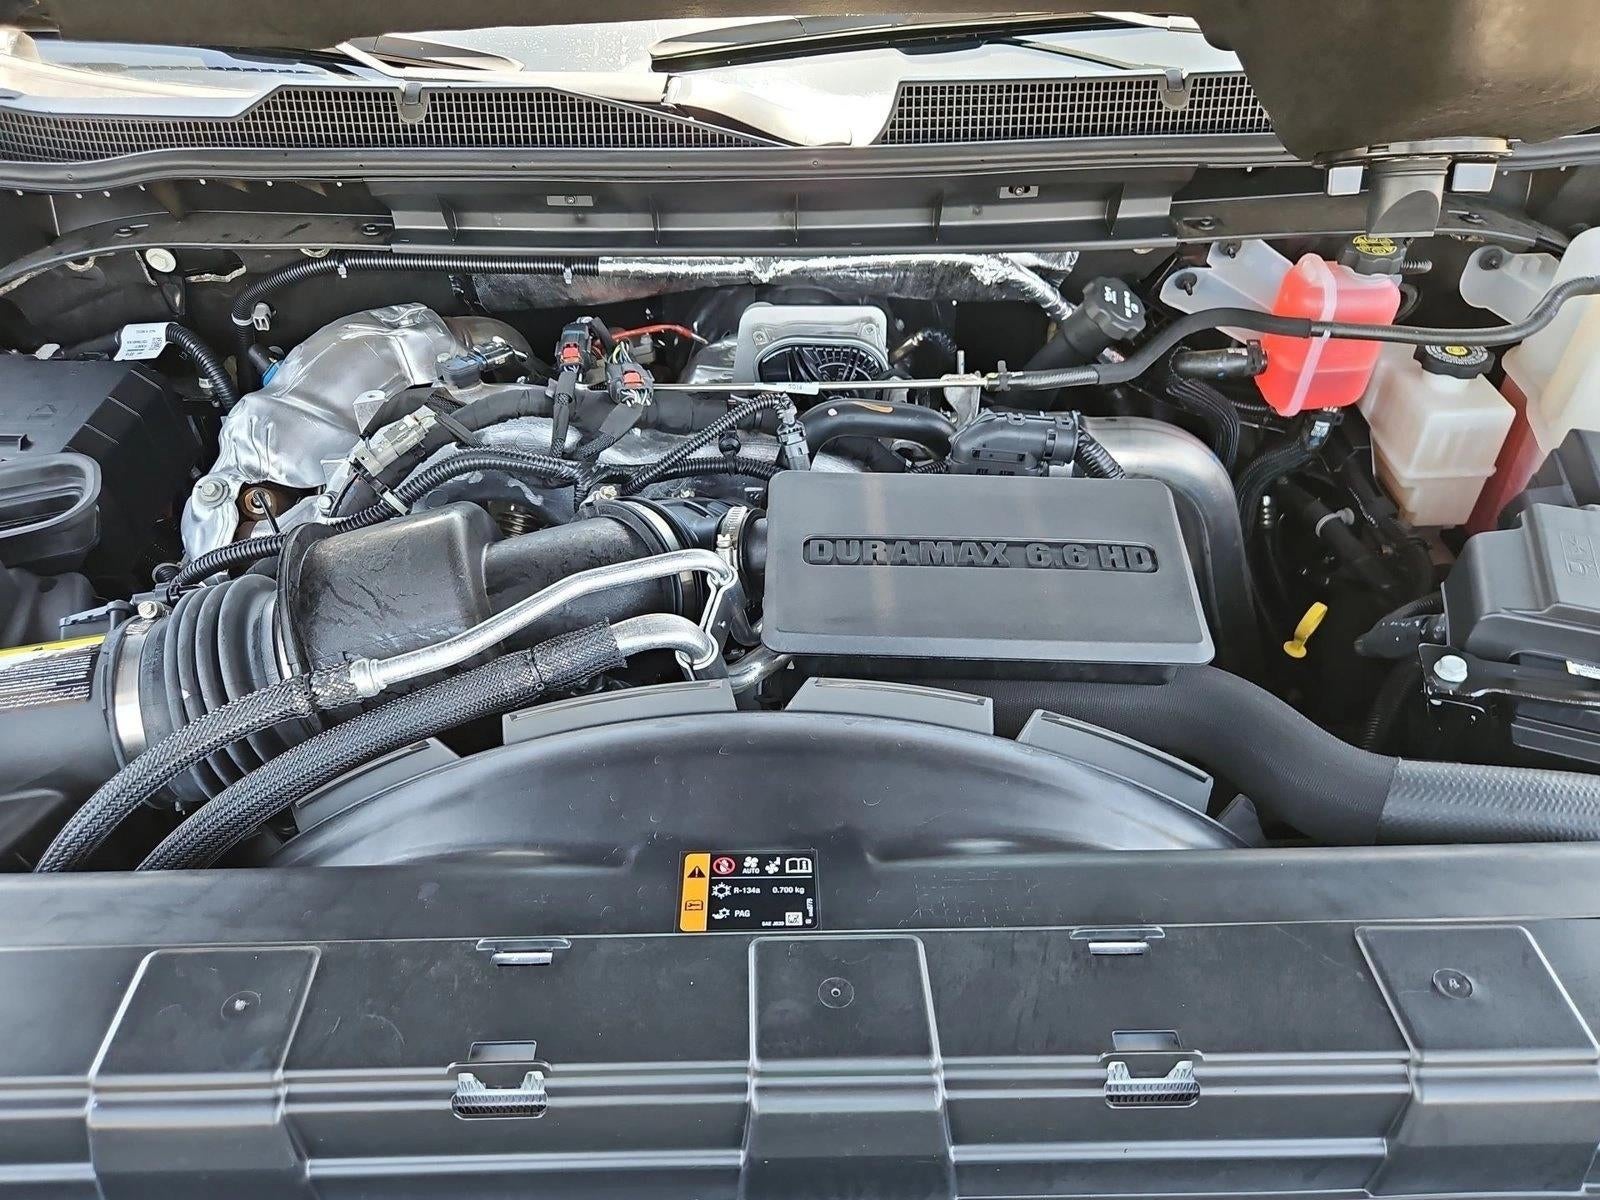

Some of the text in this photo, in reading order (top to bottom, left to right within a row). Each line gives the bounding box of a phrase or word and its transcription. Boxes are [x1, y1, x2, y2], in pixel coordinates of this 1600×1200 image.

[808, 538, 1155, 572] DURAMAX 6.6 HD
[772, 886, 794, 894] 0.700
[795, 886, 805, 895] kg
[734, 910, 751, 918] PAG
